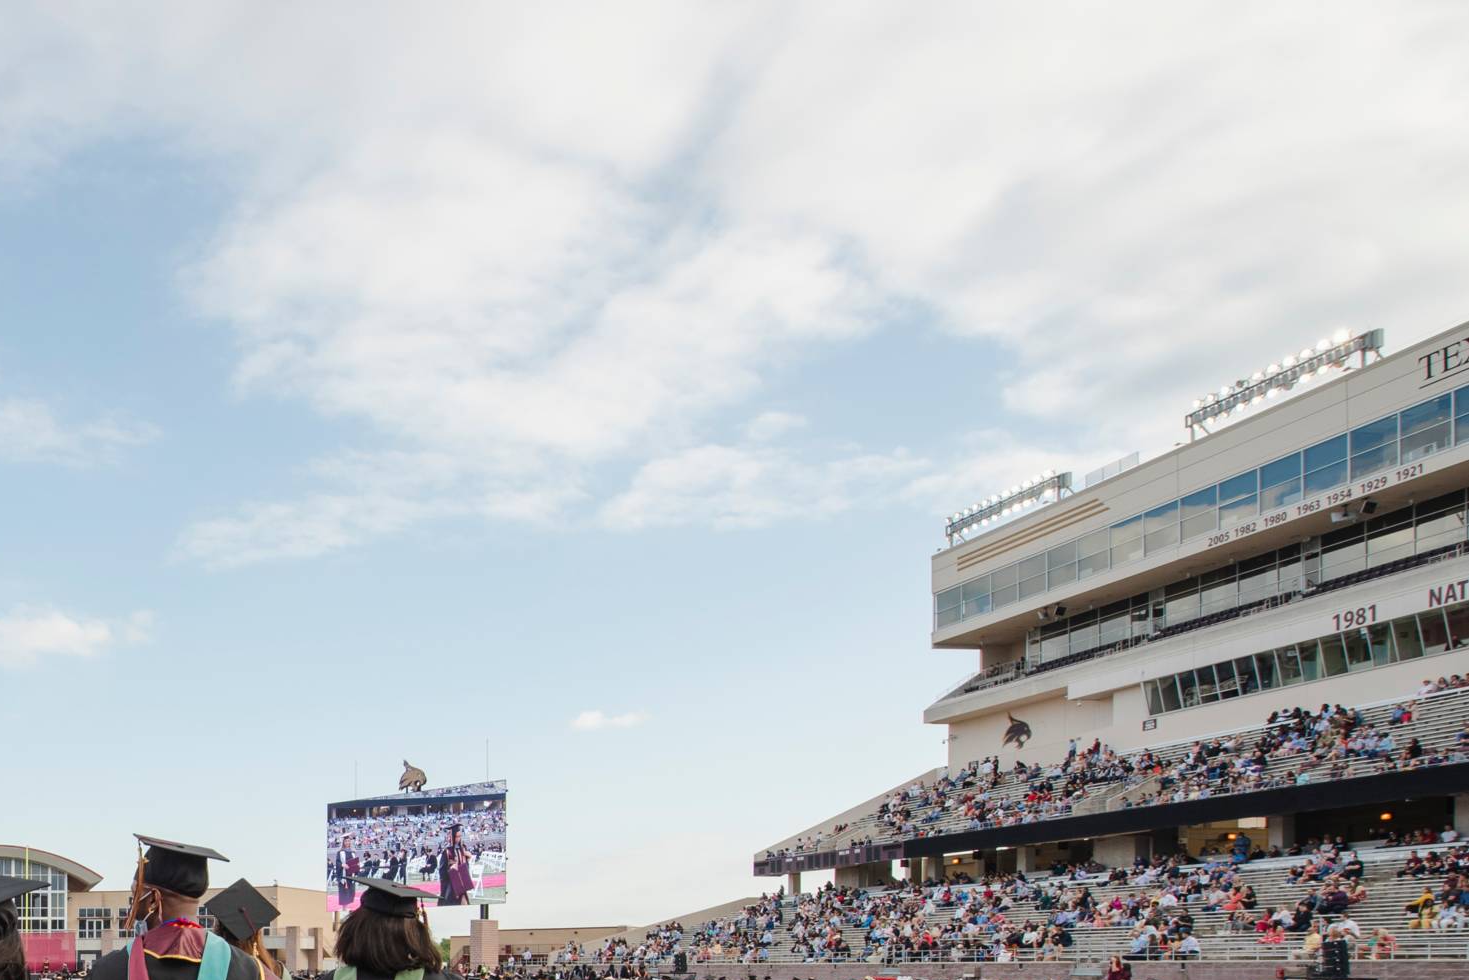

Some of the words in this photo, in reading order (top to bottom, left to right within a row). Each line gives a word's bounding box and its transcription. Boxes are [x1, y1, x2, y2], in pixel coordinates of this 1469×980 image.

[1208, 531, 1230, 547] 2005
[1234, 522, 1257, 538] 1982
[1263, 511, 1287, 528] 1980
[1296, 500, 1321, 516] 1963
[1326, 488, 1352, 506] 1954
[1360, 476, 1388, 494] 1929
[1396, 463, 1424, 482] 1921
[1332, 604, 1378, 631] 1981
